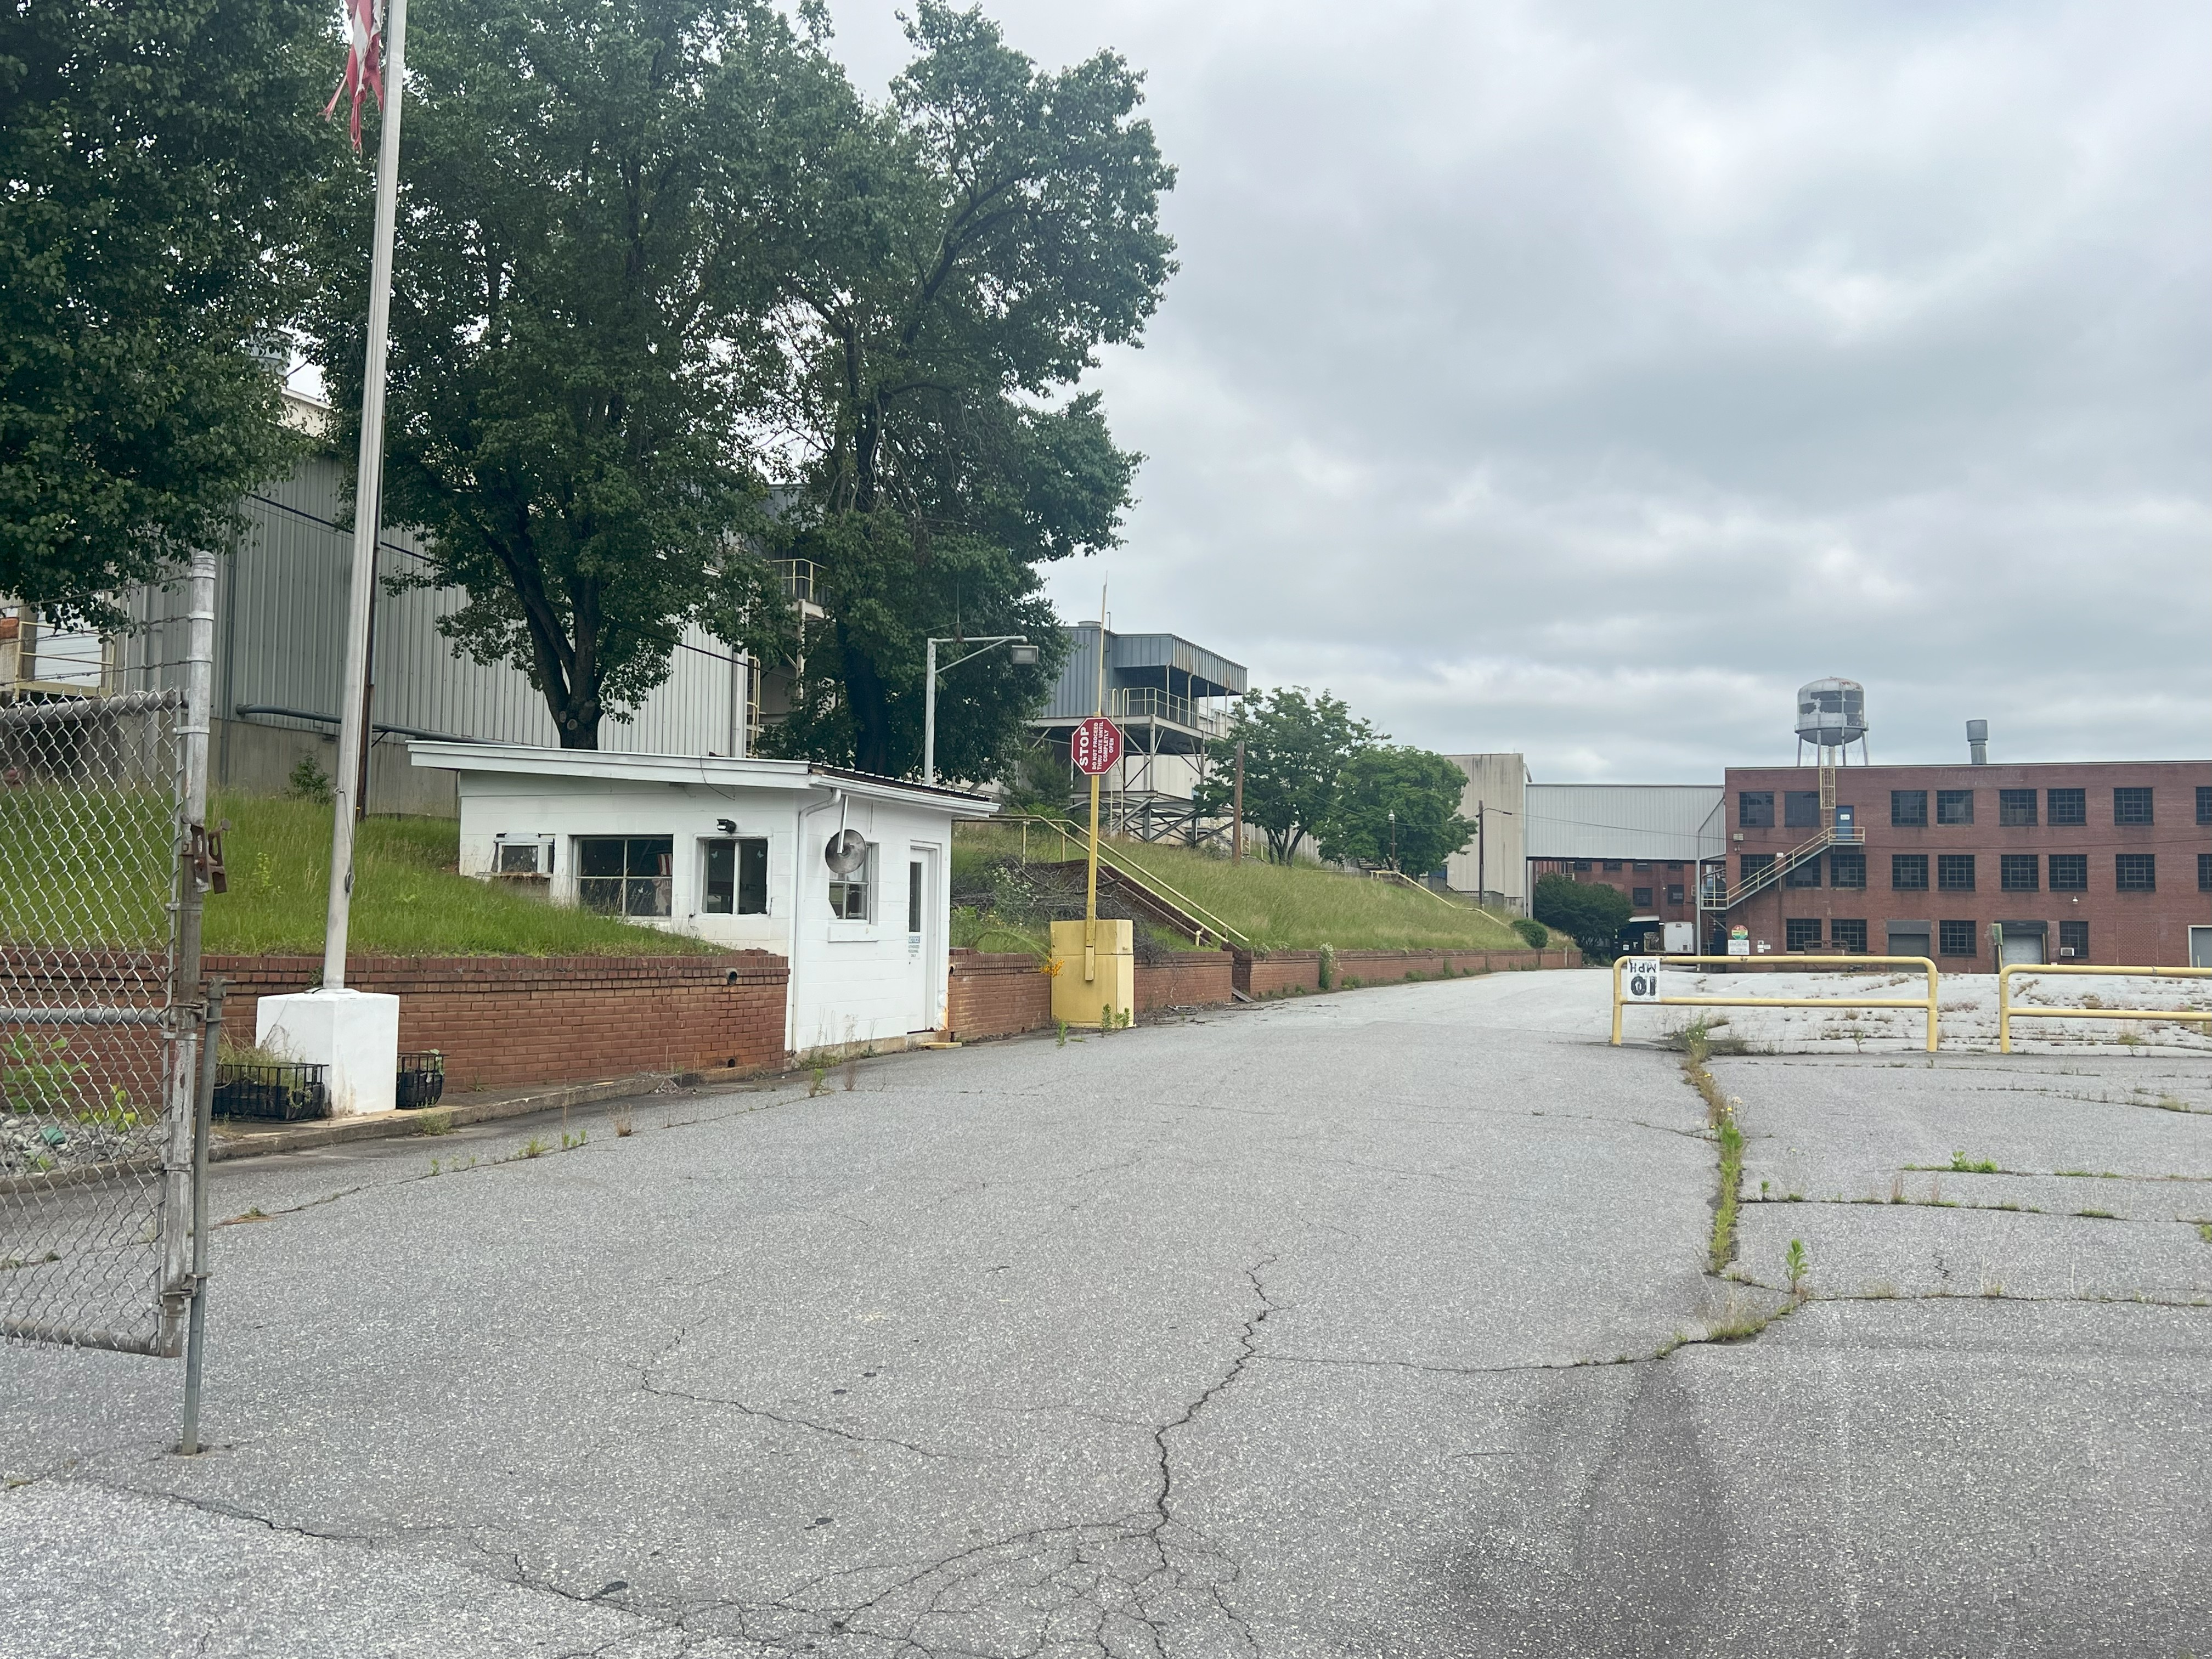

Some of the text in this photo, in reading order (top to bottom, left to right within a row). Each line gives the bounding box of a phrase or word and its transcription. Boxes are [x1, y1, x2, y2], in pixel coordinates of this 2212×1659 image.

[1079, 726, 1089, 766] STOP
[1092, 761, 1097, 770] DO
[1630, 962, 1656, 973] MPH
[1630, 975, 1657, 996] 10
